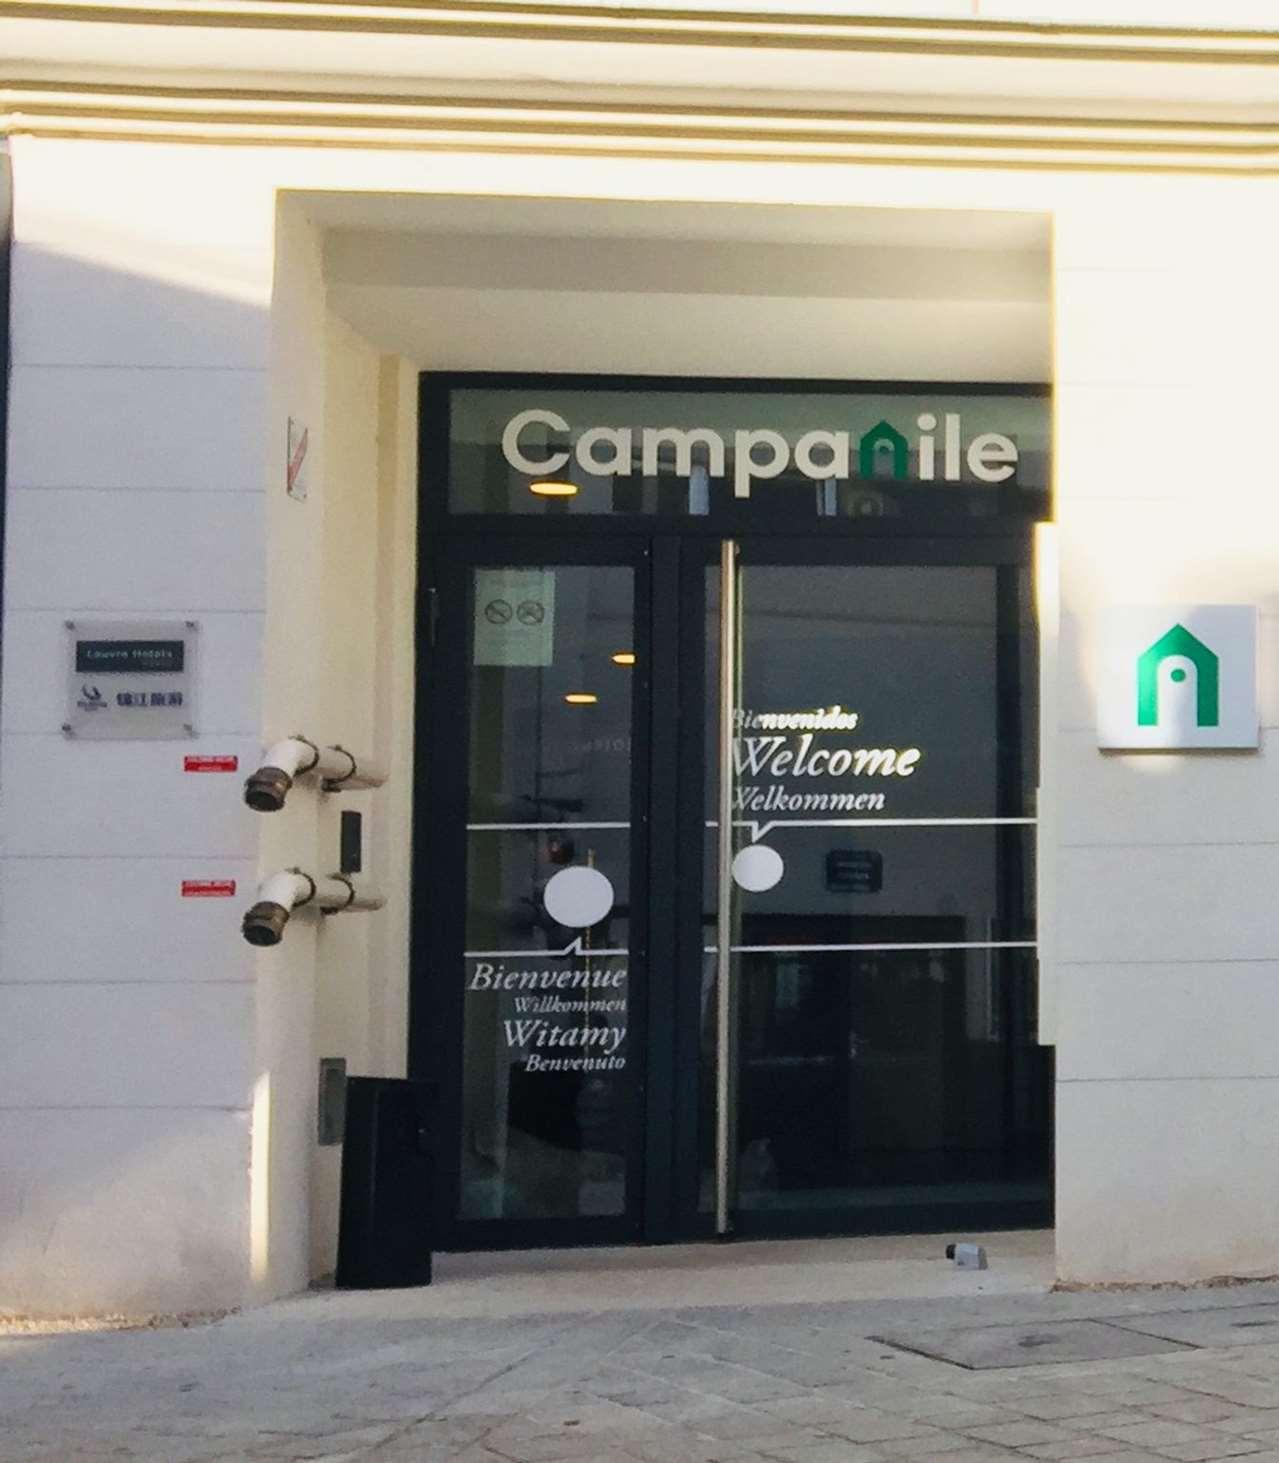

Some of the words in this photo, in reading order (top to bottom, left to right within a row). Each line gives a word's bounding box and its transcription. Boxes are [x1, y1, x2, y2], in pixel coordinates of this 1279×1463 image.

[502, 408, 1019, 499] Campanile
[733, 732, 922, 777] Welcome
[467, 962, 628, 991] Bienvenue
[514, 994, 627, 1013] Willkommen
[503, 1018, 627, 1055] Witamy
[525, 1053, 627, 1073] Benvenuto
